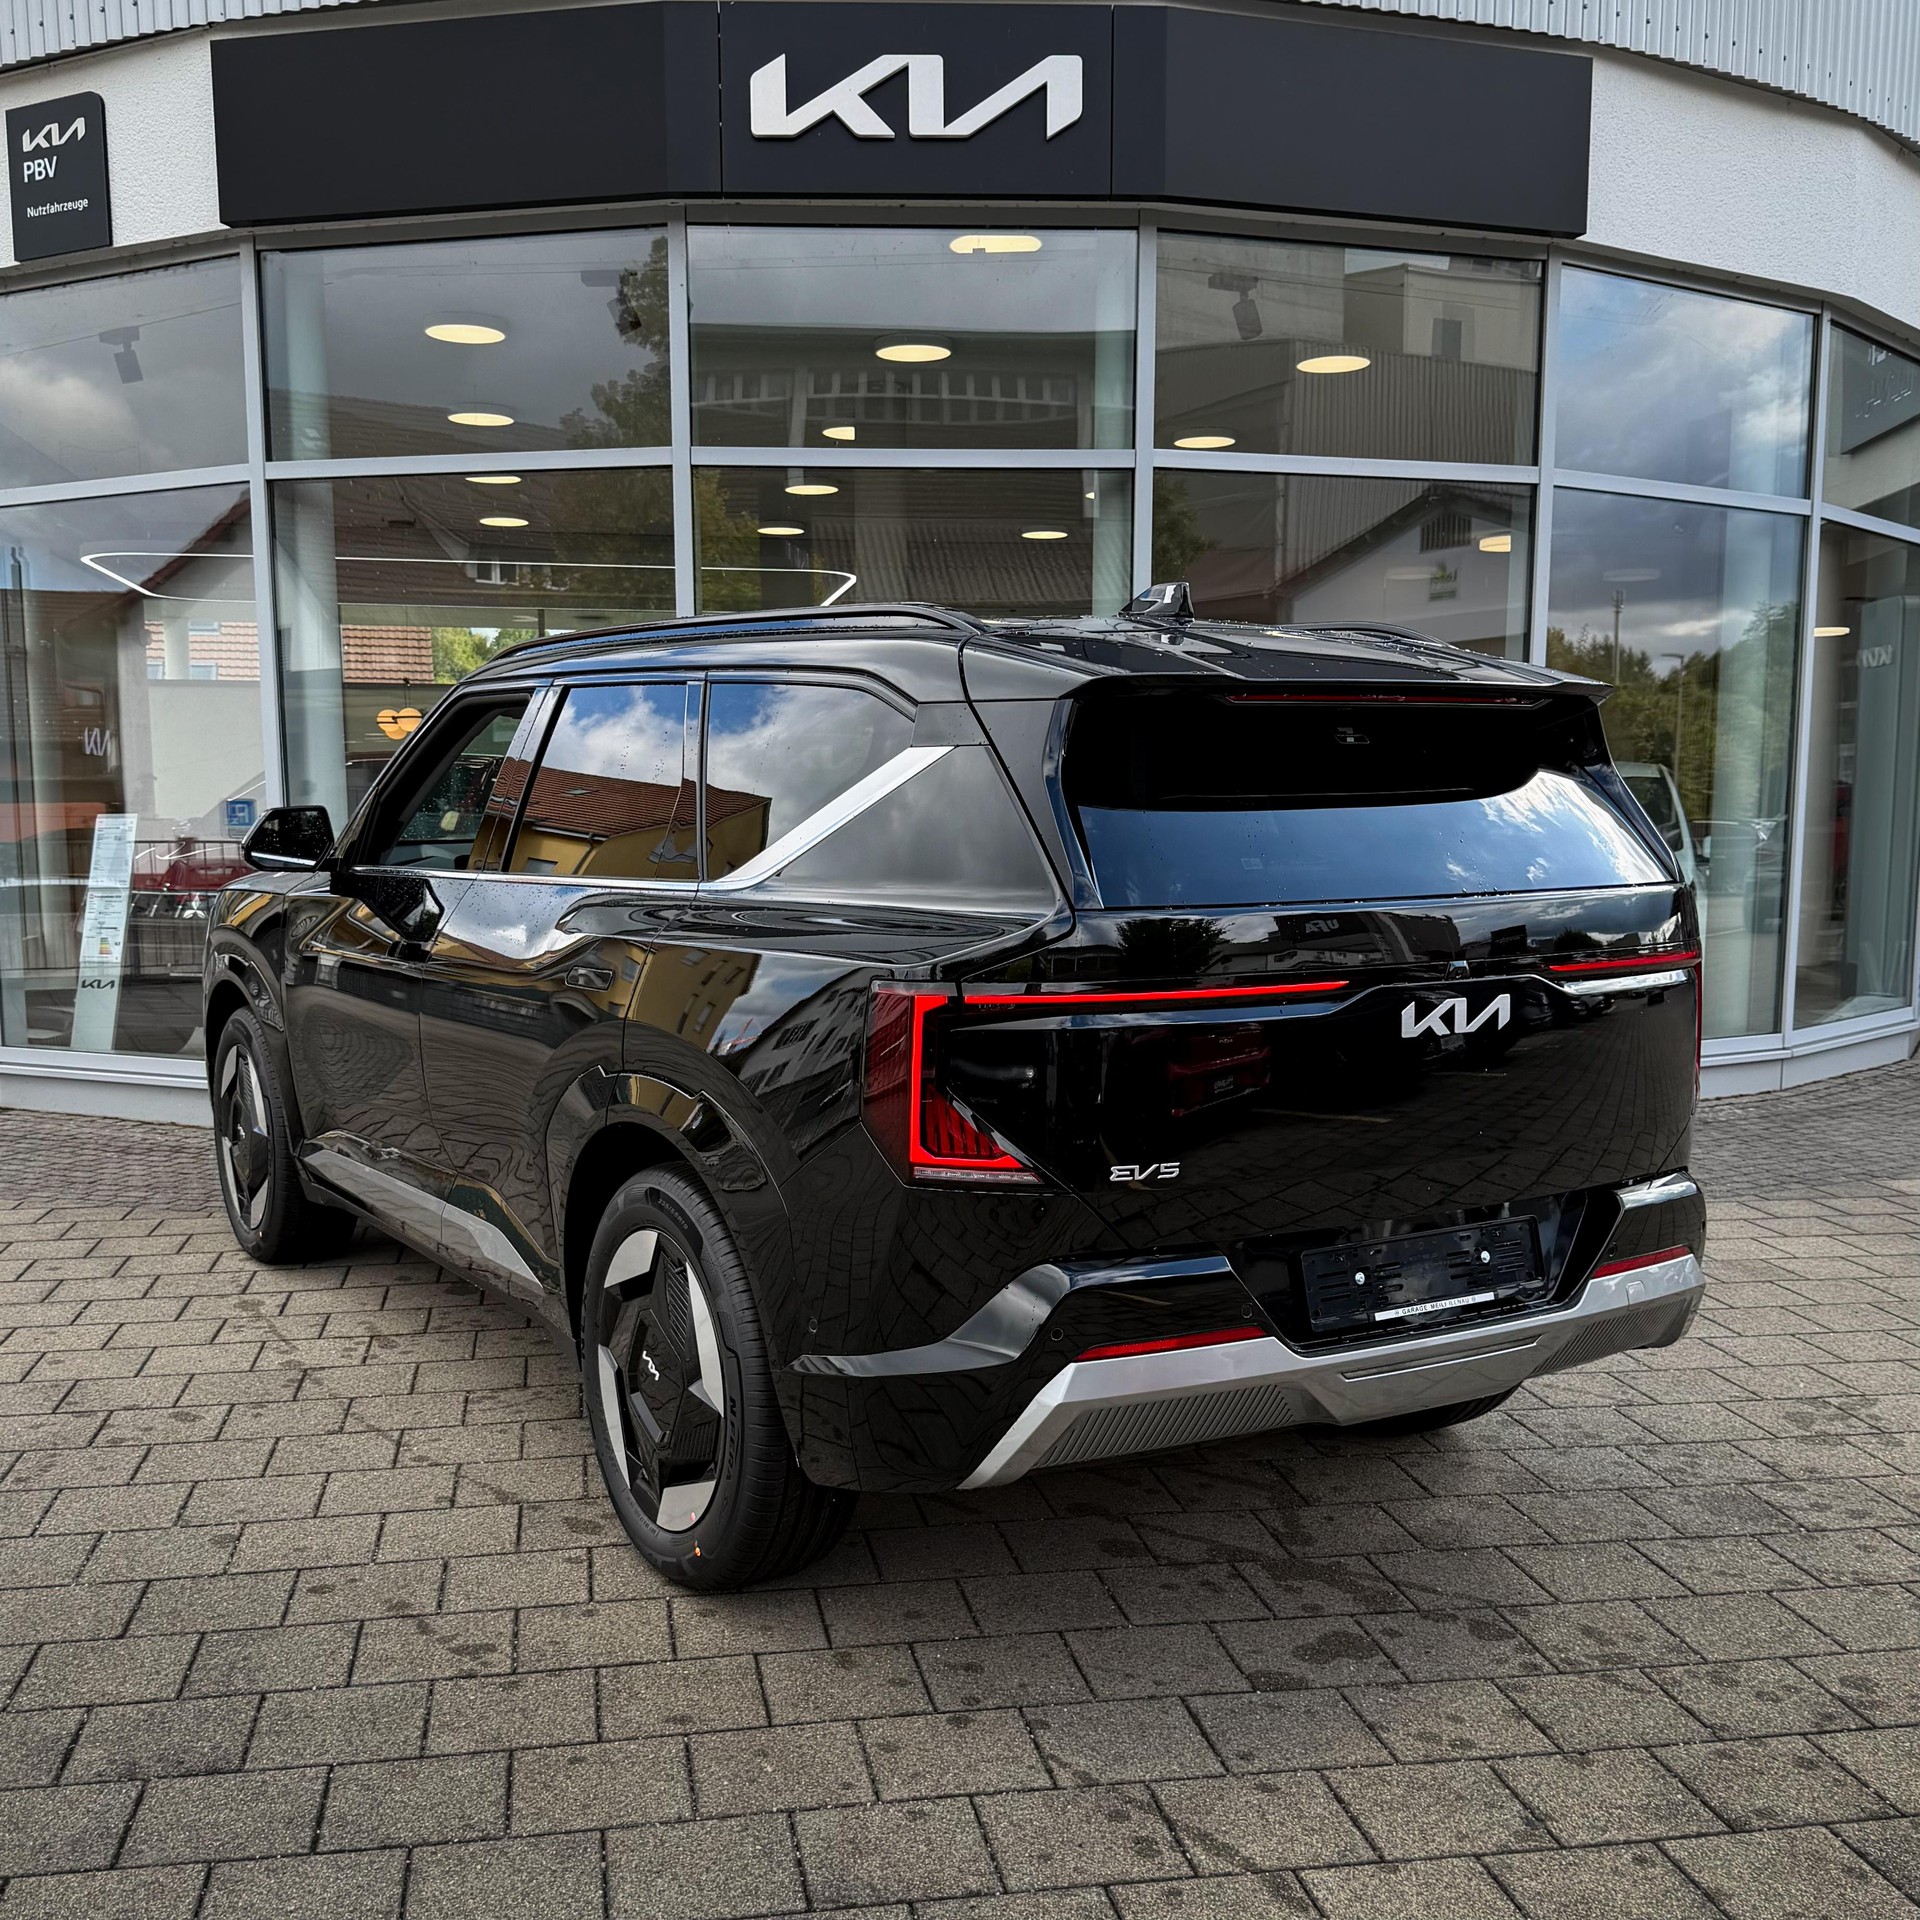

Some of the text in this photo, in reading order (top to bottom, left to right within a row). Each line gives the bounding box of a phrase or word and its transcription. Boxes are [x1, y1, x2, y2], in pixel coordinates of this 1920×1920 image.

[750, 53, 1083, 140] KIA
[22, 117, 86, 152] KIA
[23, 155, 57, 183] PBV
[27, 198, 88, 217] Nutzfahrzeuge
[81, 978, 115, 990] KIA
[1400, 993, 1511, 1039] KIA
[1109, 1162, 1181, 1182] EV5
[1402, 1305, 1428, 1314] GARAGE
